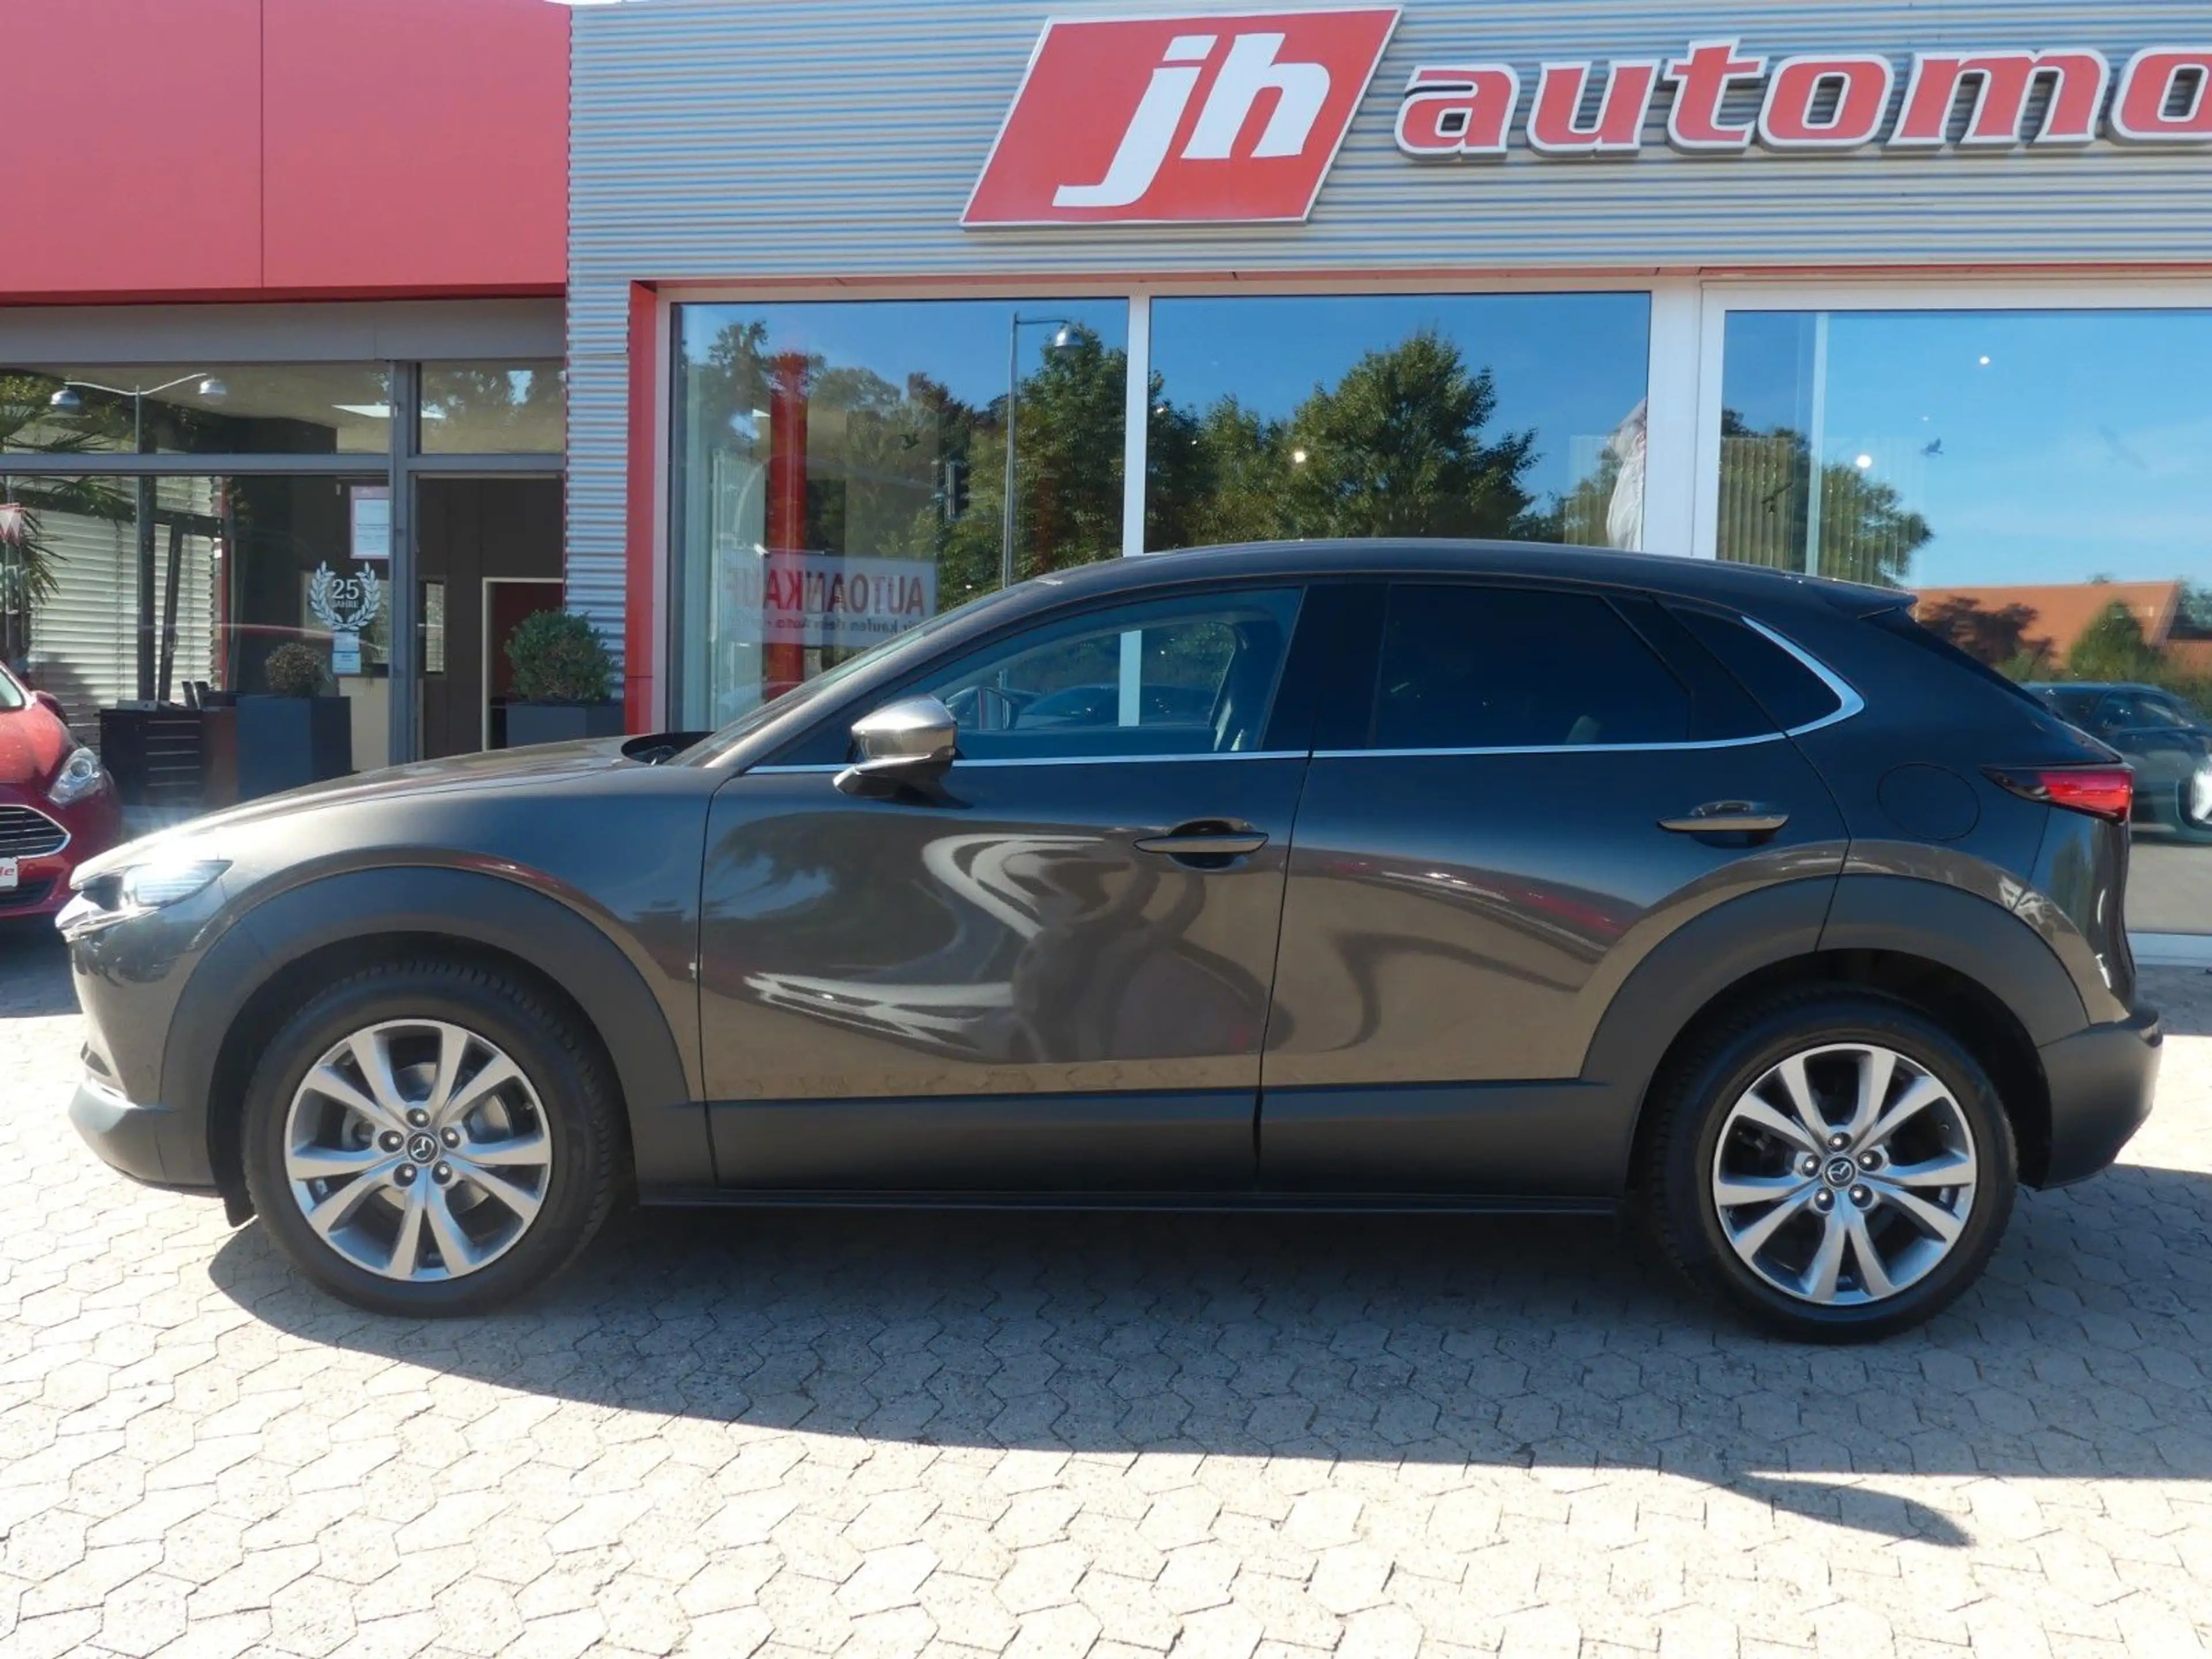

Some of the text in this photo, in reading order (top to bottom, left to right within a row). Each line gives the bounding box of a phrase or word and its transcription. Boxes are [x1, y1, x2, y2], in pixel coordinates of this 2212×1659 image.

[1052, 32, 2212, 207] jh automo
[332, 579, 359, 599] 25
